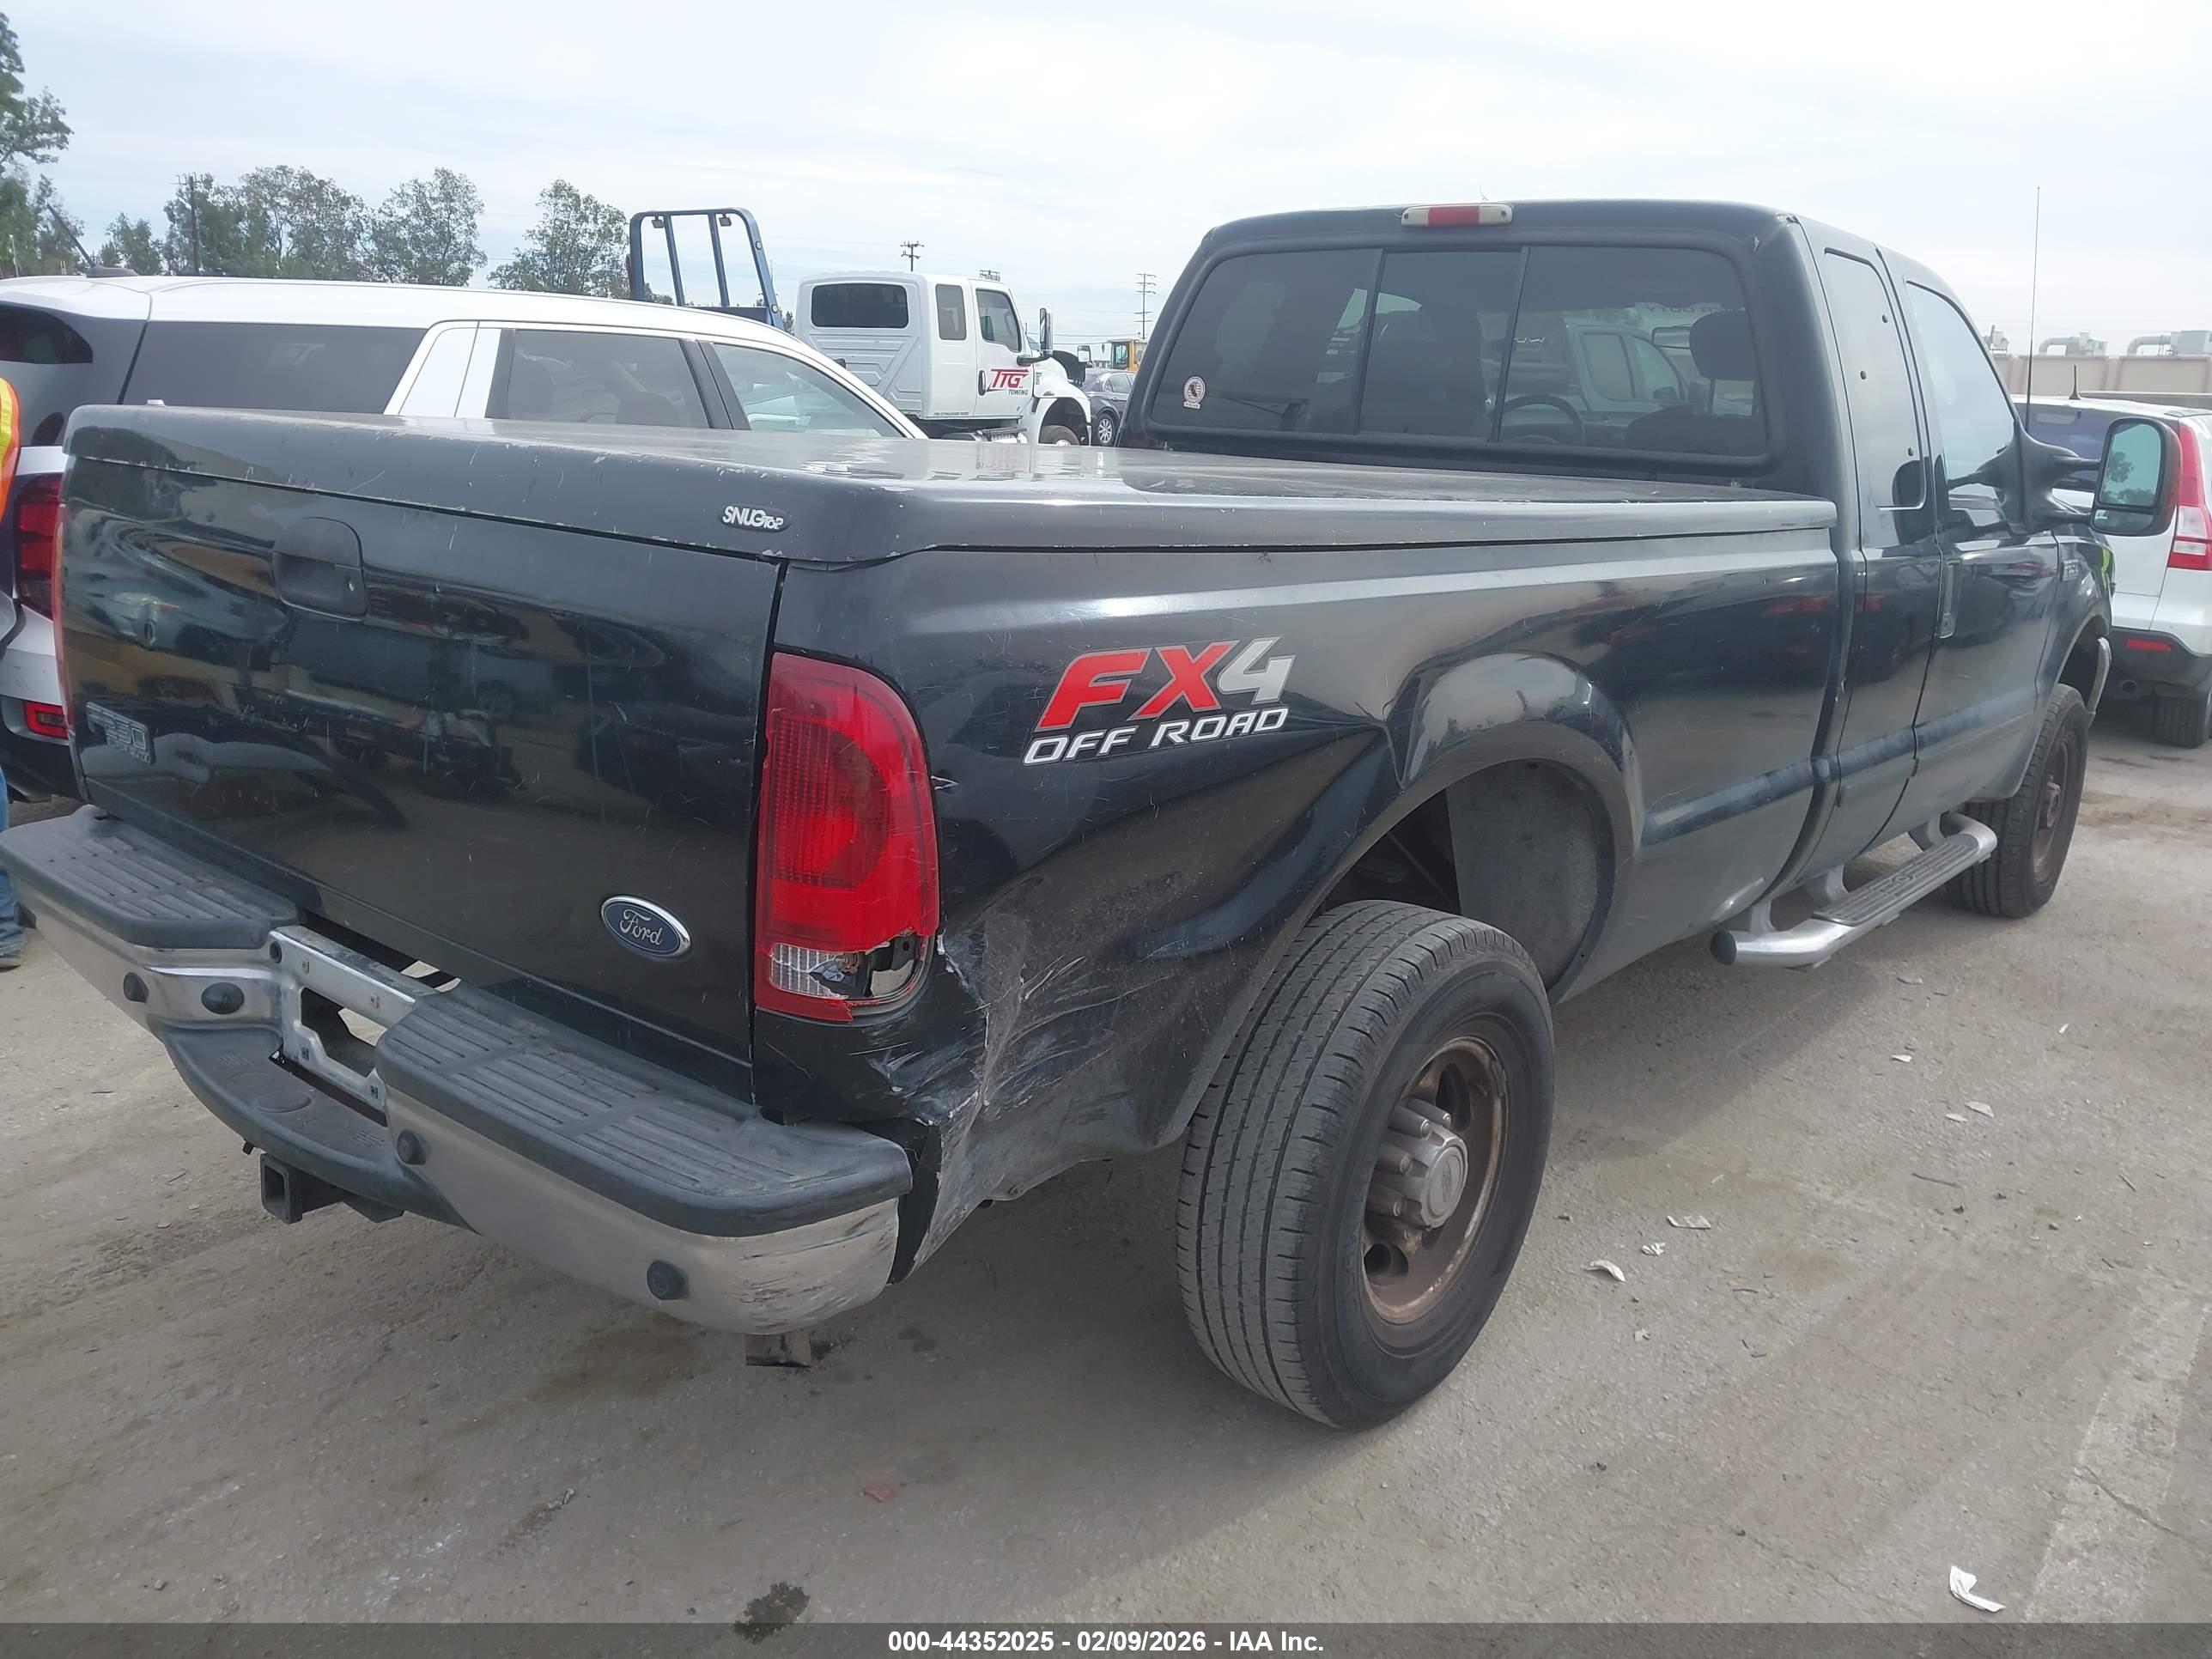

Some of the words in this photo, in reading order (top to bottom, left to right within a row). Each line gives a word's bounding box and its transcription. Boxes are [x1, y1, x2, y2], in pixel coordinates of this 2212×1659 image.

[990, 368, 1030, 388] TTG
[1034, 636, 1296, 732] FX4
[1023, 726, 1139, 766] OFF
[1148, 706, 1289, 750] ROAD
[619, 908, 663, 945] Ford
